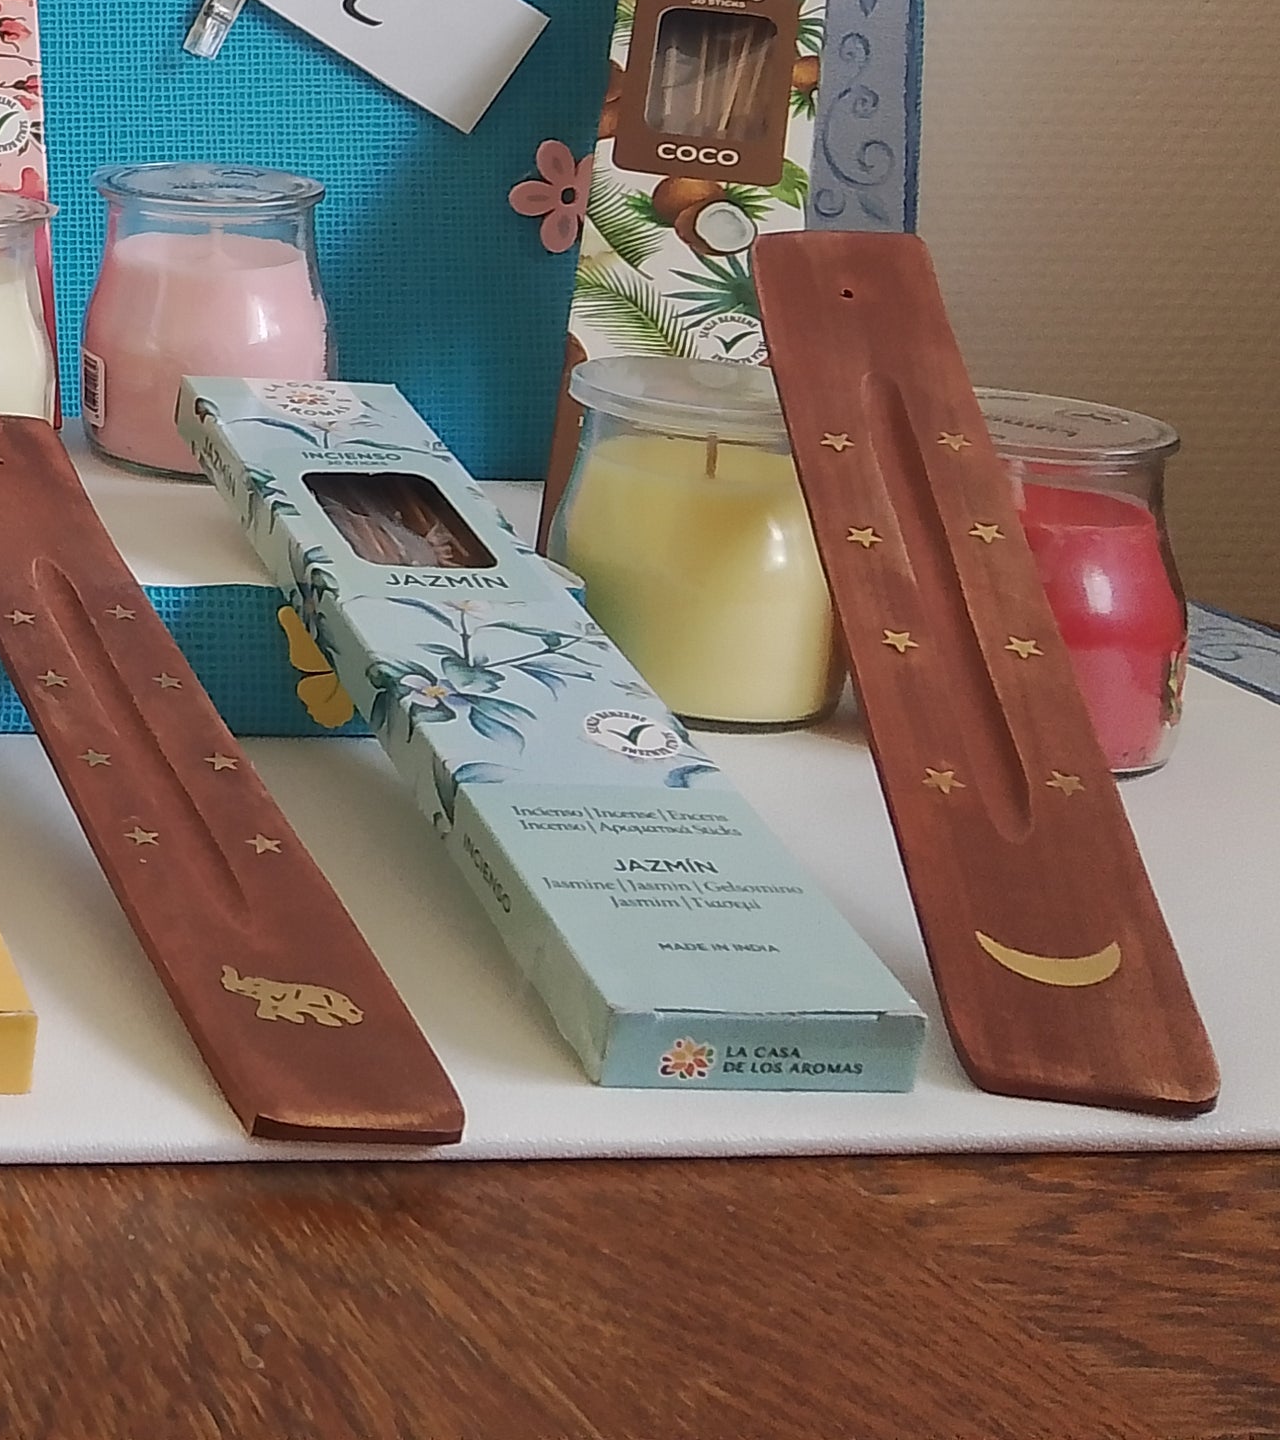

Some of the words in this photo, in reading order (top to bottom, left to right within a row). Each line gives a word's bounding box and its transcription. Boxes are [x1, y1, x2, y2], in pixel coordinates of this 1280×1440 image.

[657, 142, 740, 167] COCO
[286, 381, 337, 396] CASA
[277, 402, 351, 417] AROMAS
[301, 450, 403, 462] INCIENSO
[385, 573, 510, 589] JAZMÍN
[511, 805, 584, 818] Incienso
[591, 807, 659, 821] Incense
[666, 809, 729, 823] Encens
[519, 819, 587, 832] Incenso
[691, 823, 743, 837] Sticks
[612, 857, 720, 874] JAZMÍN
[542, 876, 616, 891] Jasmine
[626, 879, 692, 893] Jasmin
[704, 881, 805, 895] Gelsomino
[609, 895, 681, 910] Jasmim
[657, 942, 705, 953] MADE
[710, 943, 728, 952] IN
[731, 943, 781, 953] INDIA
[725, 1046, 748, 1058] LA
[753, 1046, 801, 1058] CASA
[722, 1061, 747, 1073] DE
[750, 1062, 783, 1074] LOS
[789, 1062, 863, 1076] AROMAS
